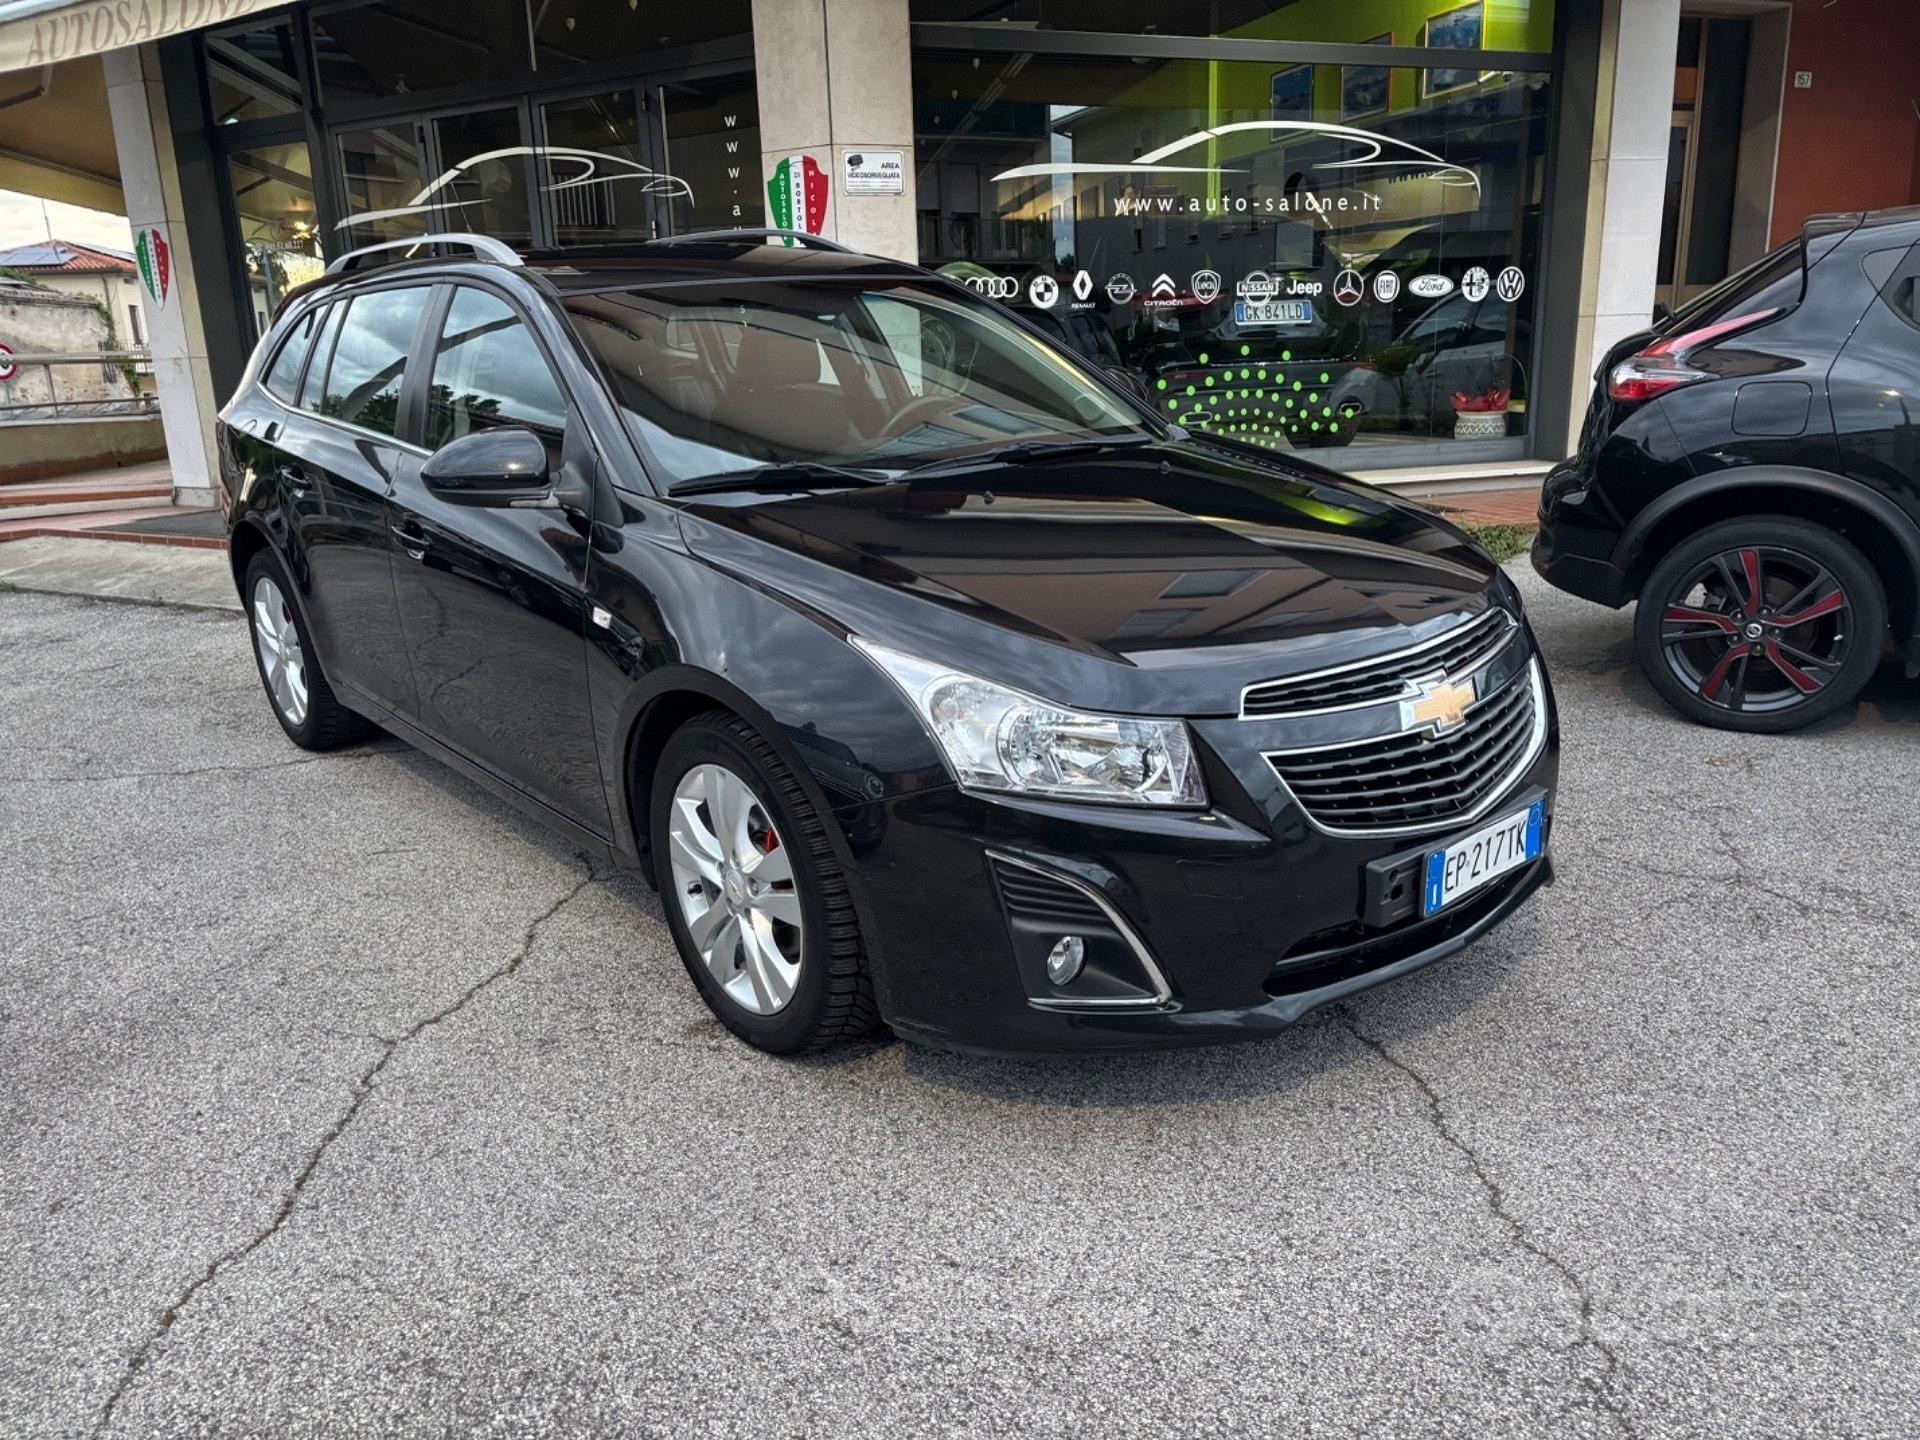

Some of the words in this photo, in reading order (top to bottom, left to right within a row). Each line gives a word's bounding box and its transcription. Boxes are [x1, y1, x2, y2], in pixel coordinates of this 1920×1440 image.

[1113, 191, 1382, 212] www.auto-salone.it
[1240, 283, 1275, 292] NISSAN
[1286, 279, 1323, 296] Jeep
[1420, 277, 1444, 292] Ford
[1070, 302, 1096, 310] RENAULT
[1444, 850, 1467, 892] EP
[1470, 818, 1526, 879] 217TK
